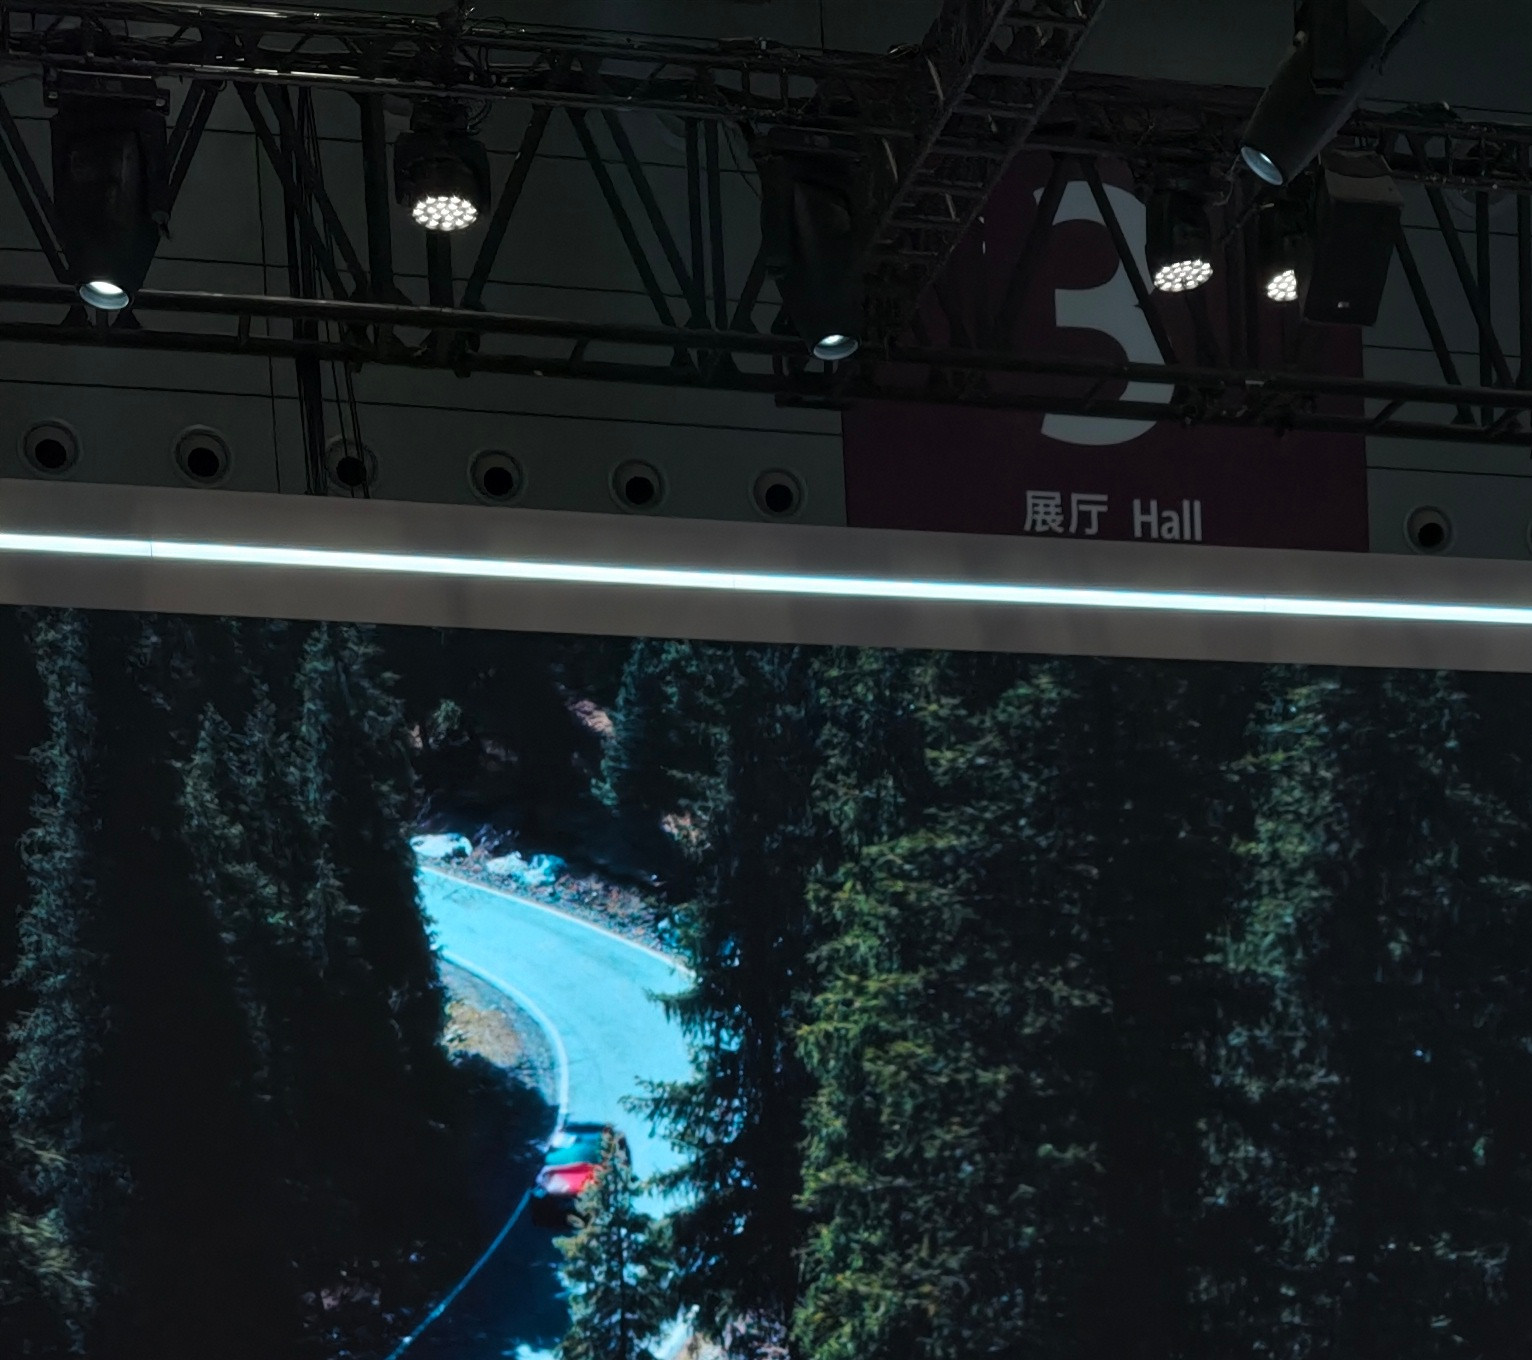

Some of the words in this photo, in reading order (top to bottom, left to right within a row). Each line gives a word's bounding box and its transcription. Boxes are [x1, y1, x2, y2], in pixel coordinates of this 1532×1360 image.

[1033, 178, 1176, 447] 3
[1023, 489, 1110, 536] 展厅
[1132, 498, 1203, 543] Hall
